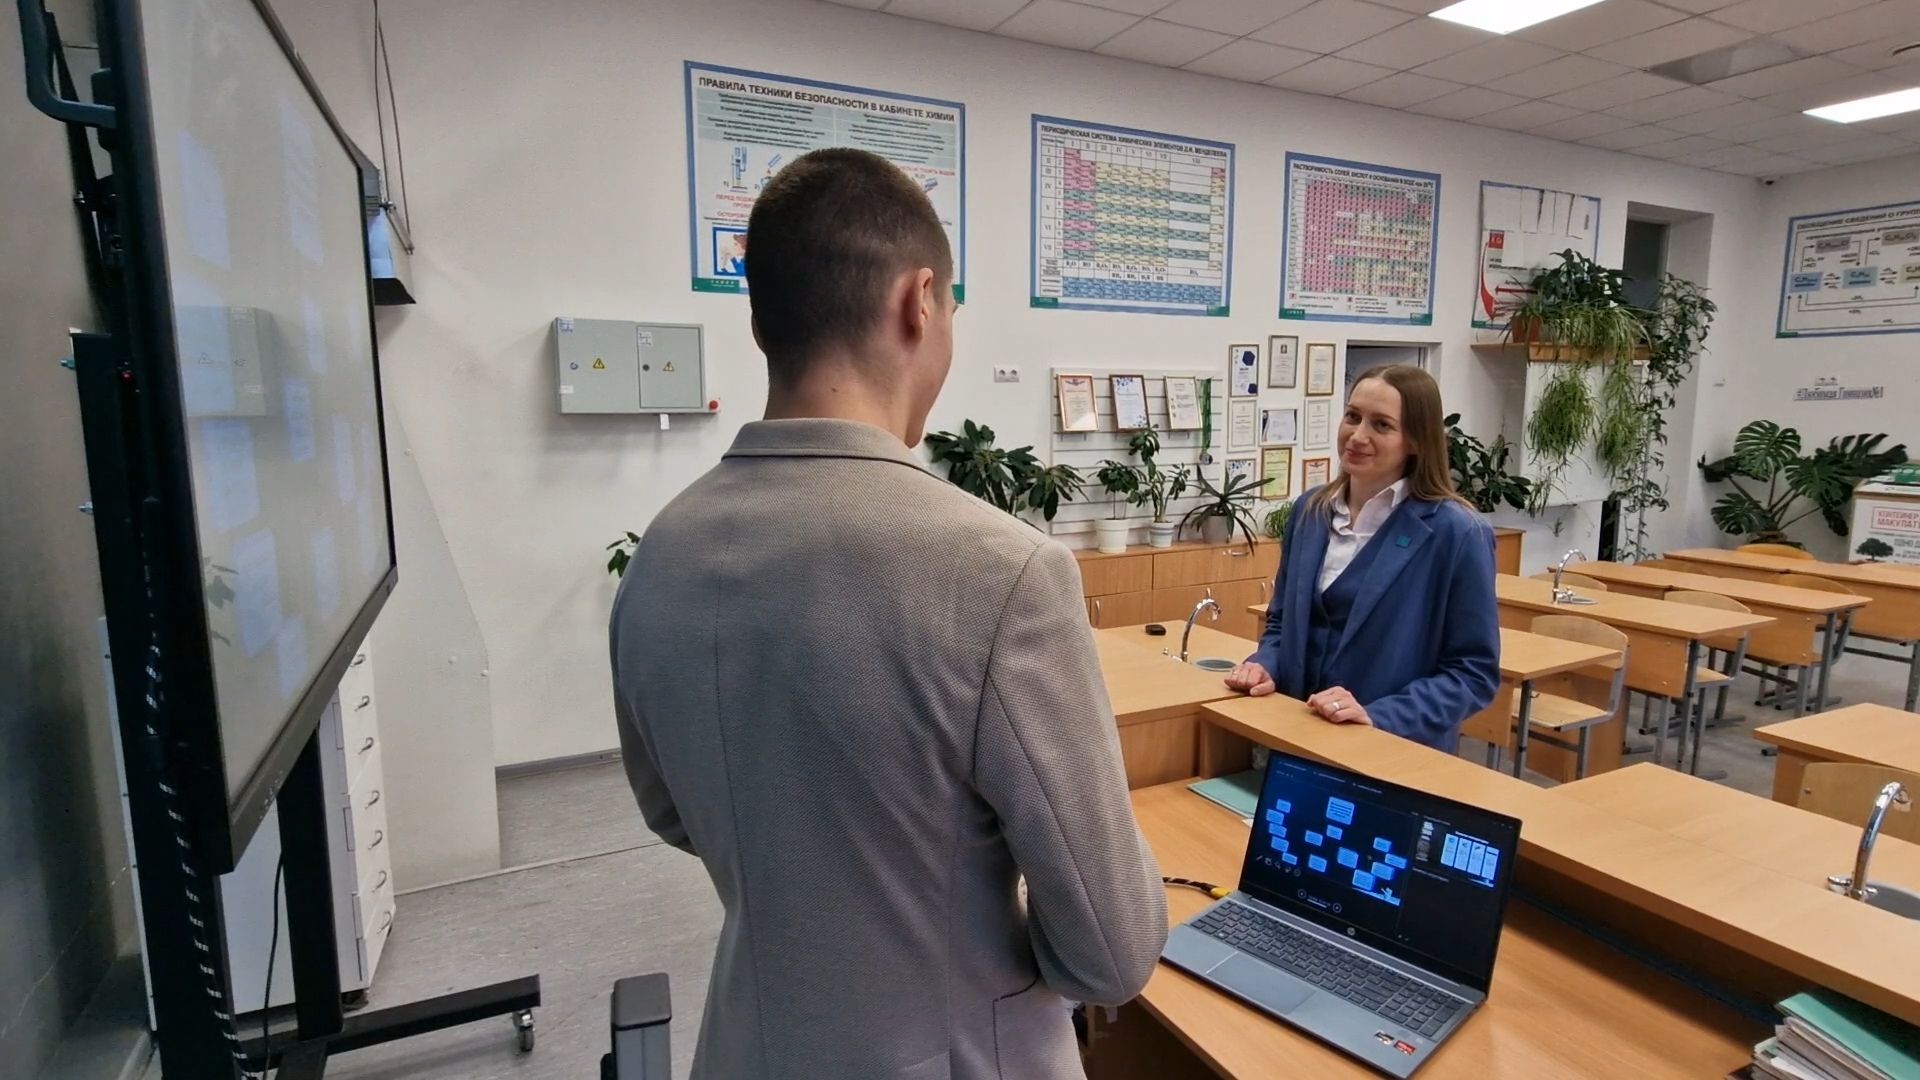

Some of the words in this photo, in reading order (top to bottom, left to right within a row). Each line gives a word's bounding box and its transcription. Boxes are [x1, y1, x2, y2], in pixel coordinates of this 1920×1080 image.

[698, 77, 747, 92] ПРАВИЛА
[749, 84, 793, 99] ТЕХНИКИ
[794, 91, 869, 109] БЕЗОПАСНОСТИ
[871, 103, 877, 111] В
[879, 104, 924, 118] КАБИНЕТЕ
[926, 110, 955, 122] ХИМИИ
[1041, 125, 1090, 138] ПЕРИОДИЧЕСКАЯ
[1091, 132, 1117, 142] СИСТЕМА
